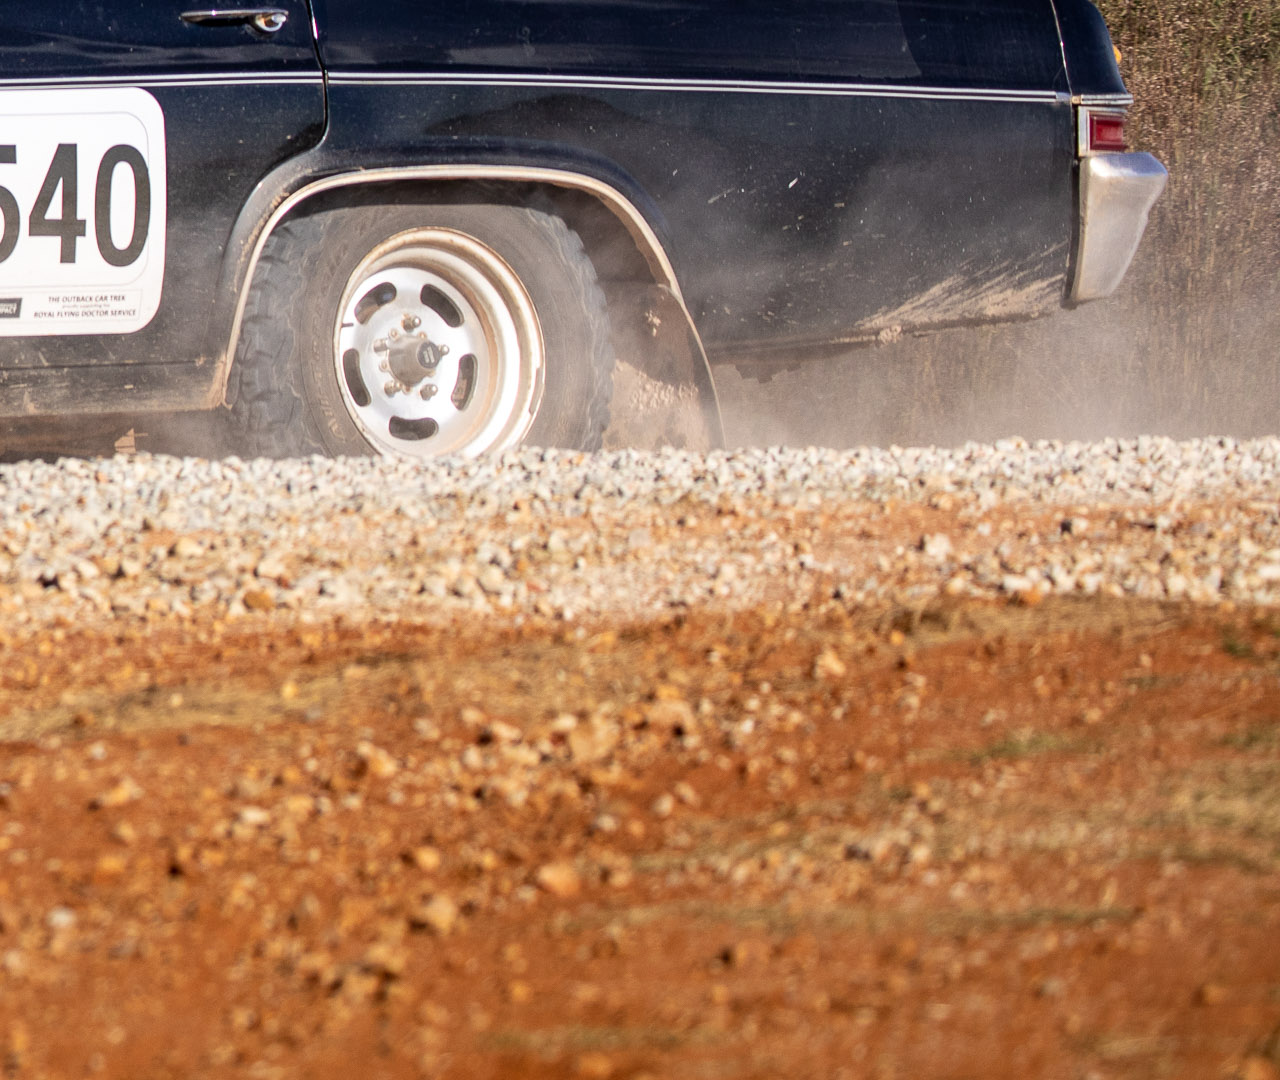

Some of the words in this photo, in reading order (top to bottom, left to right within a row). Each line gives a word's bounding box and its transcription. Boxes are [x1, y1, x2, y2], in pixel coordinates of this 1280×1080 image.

[62, 295, 93, 303] OUTBACK
[110, 294, 126, 302] TREK
[111, 309, 136, 317] SERVICE
